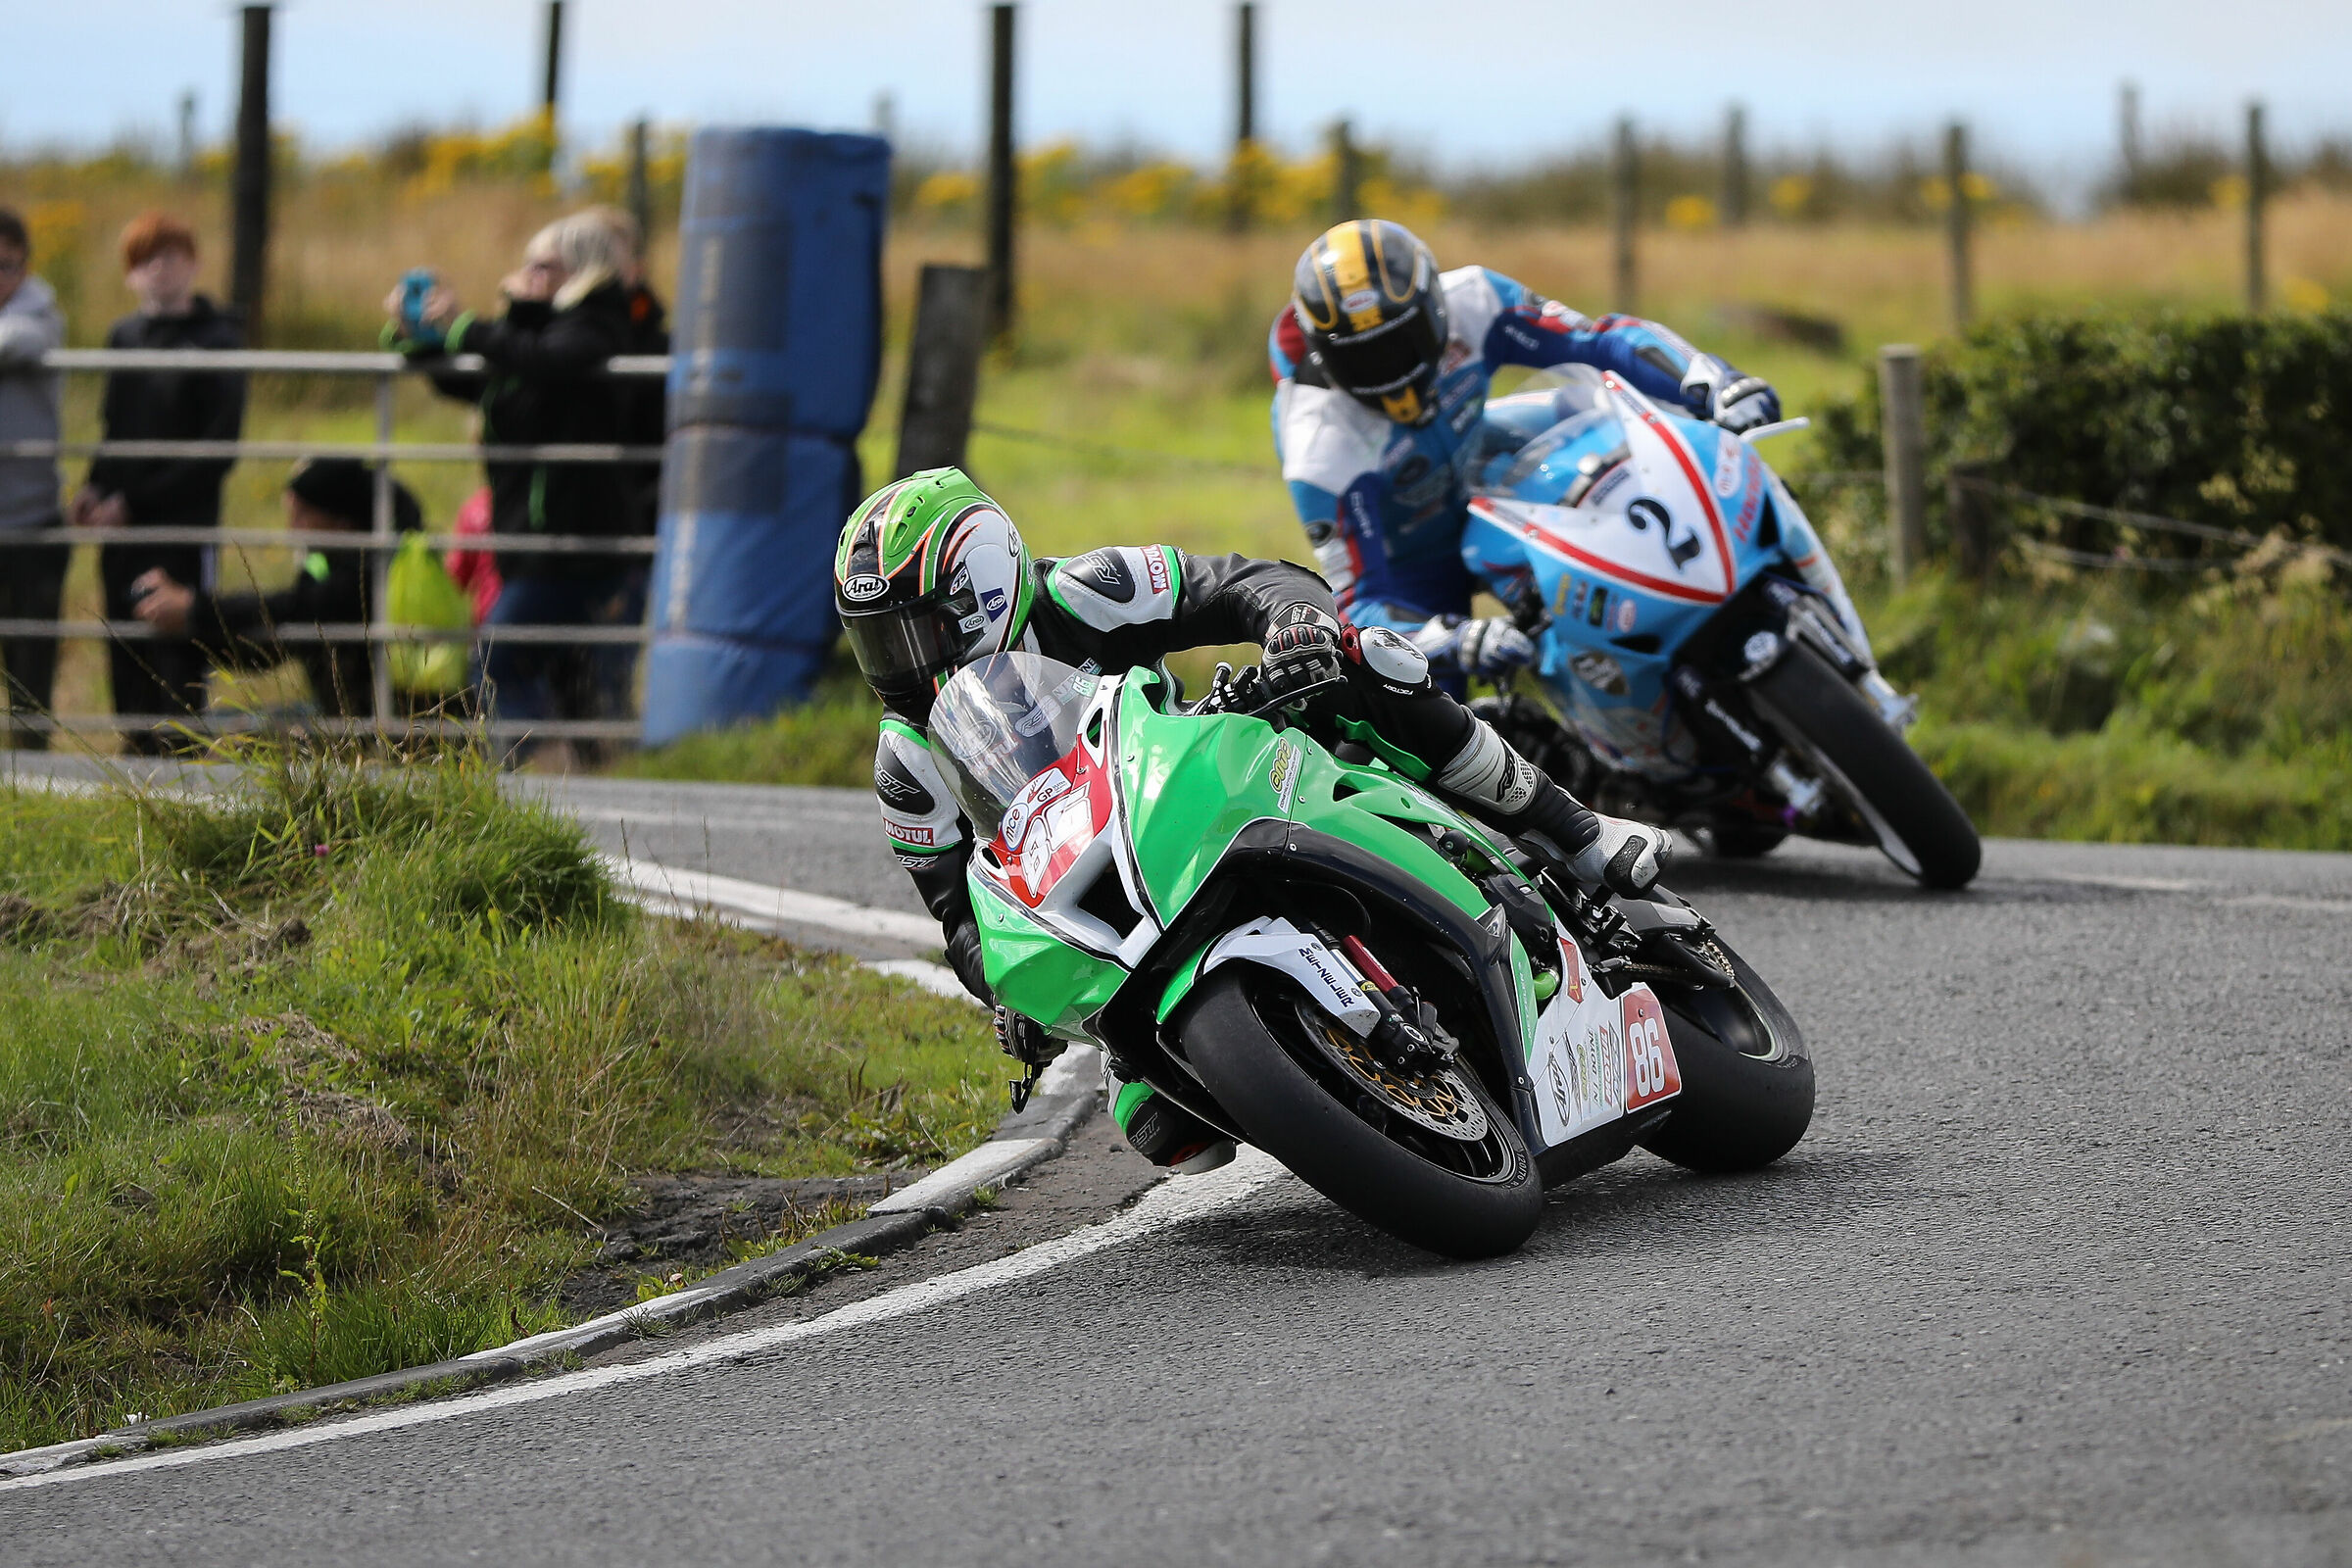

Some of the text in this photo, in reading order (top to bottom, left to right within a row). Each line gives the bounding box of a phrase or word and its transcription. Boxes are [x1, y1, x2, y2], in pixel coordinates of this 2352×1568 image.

[1627, 498, 1701, 571] 2
[846, 578, 884, 594] Arai
[1037, 787, 1054, 803] GP
[884, 821, 932, 844] MOTUL
[1298, 947, 1355, 1008] METZELER
[1629, 1017, 1667, 1099] 86
